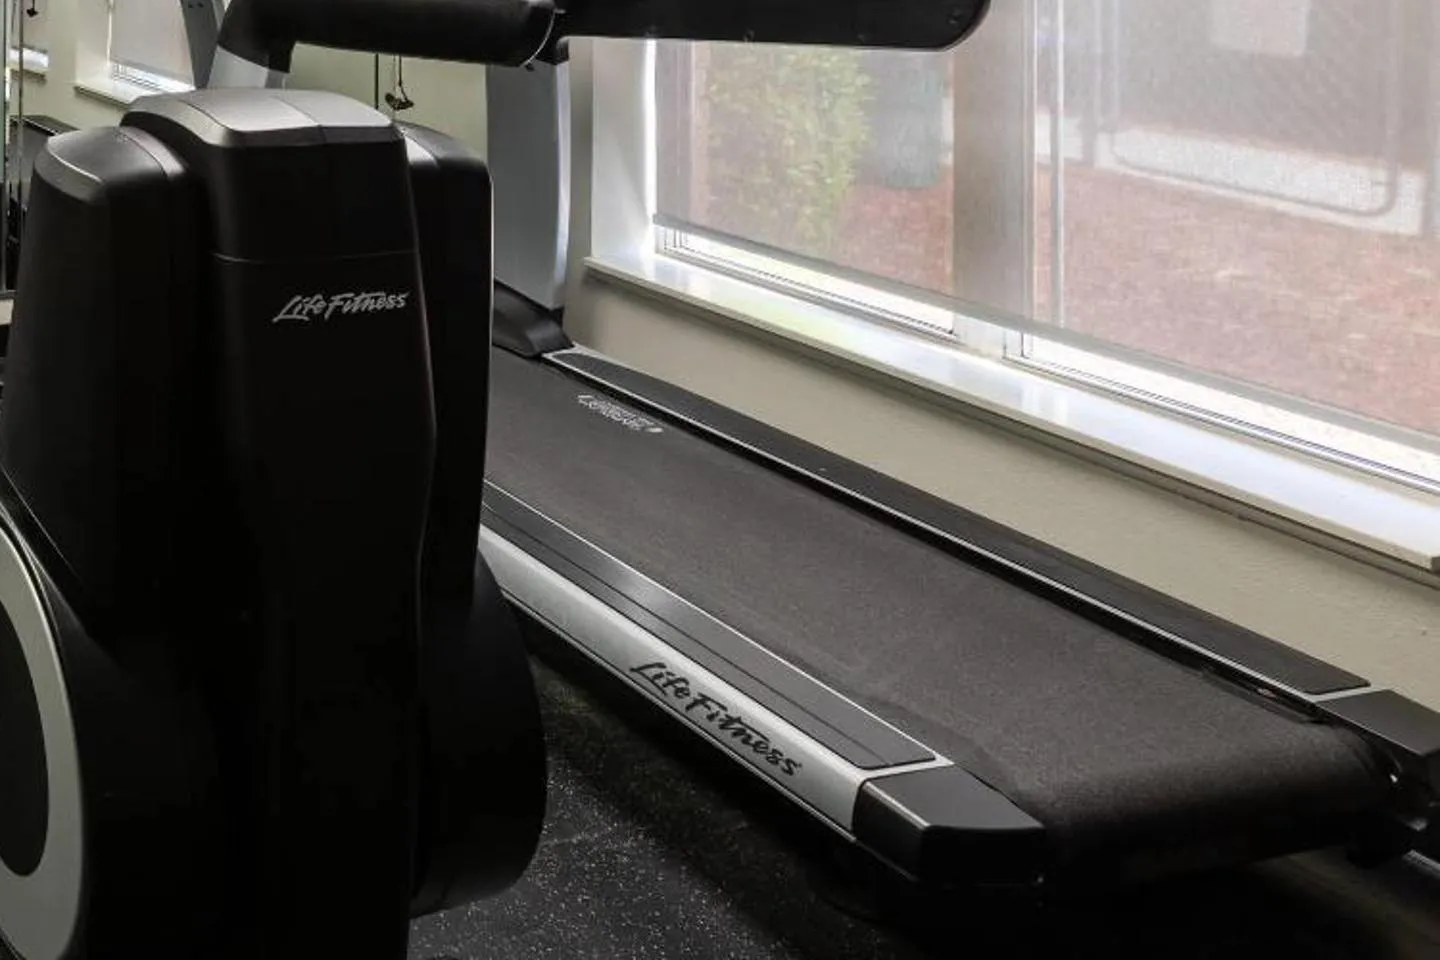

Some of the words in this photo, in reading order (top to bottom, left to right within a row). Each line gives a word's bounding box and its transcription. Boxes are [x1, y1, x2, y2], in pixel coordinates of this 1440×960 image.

[272, 294, 327, 323] Life
[324, 291, 409, 320] Fitness
[629, 662, 691, 699] Life
[685, 692, 802, 776] Fitness
